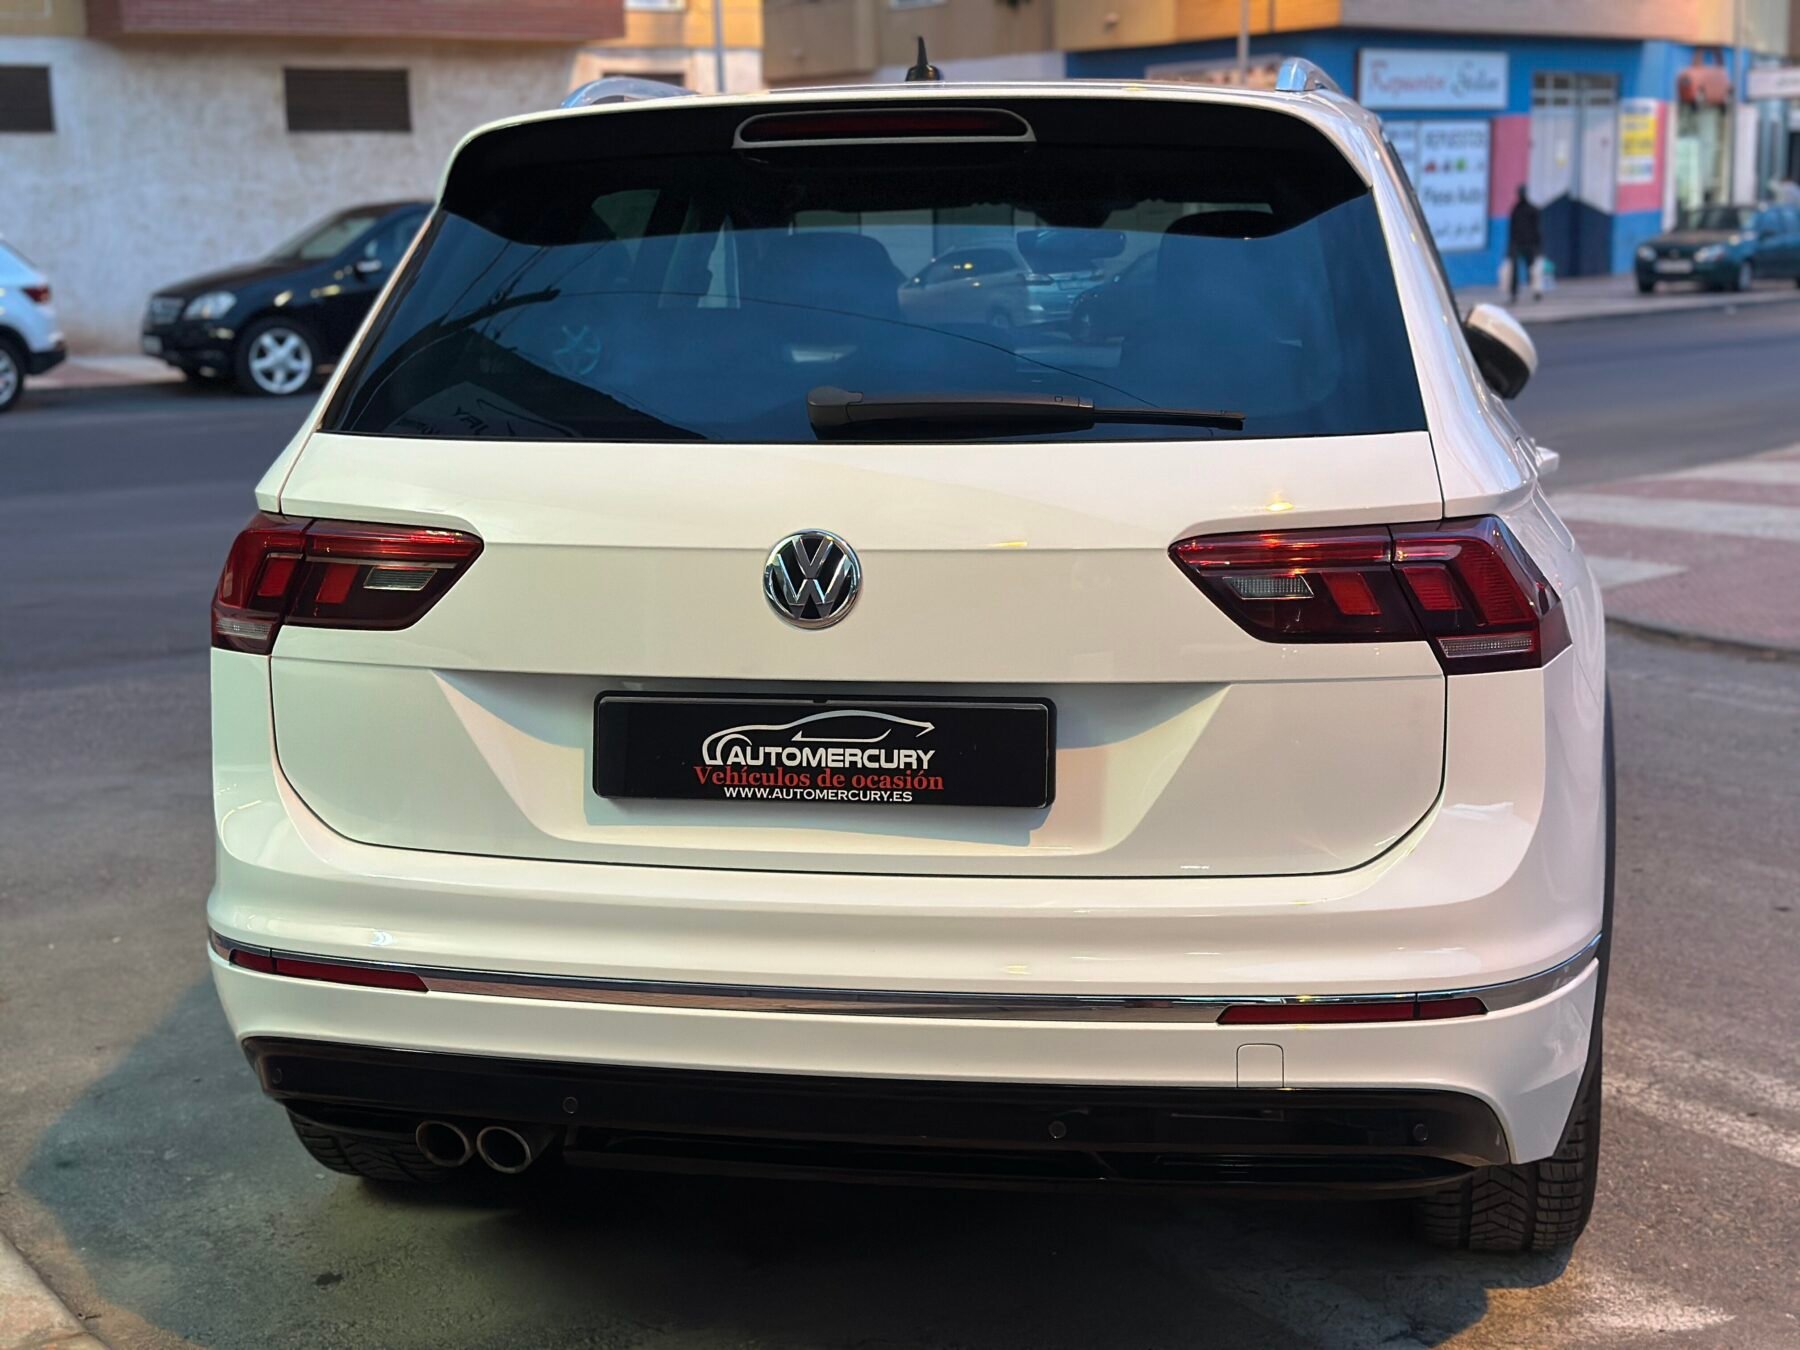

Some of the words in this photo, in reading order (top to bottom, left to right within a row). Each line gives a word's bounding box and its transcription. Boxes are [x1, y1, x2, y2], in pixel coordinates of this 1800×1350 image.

[726, 746, 935, 769] AUTOMERCURY
[693, 766, 811, 787] Vehículos
[817, 768, 846, 788] de
[852, 770, 944, 790] ocasión
[724, 787, 913, 802] WWW.AUTOMERCURY.ES
